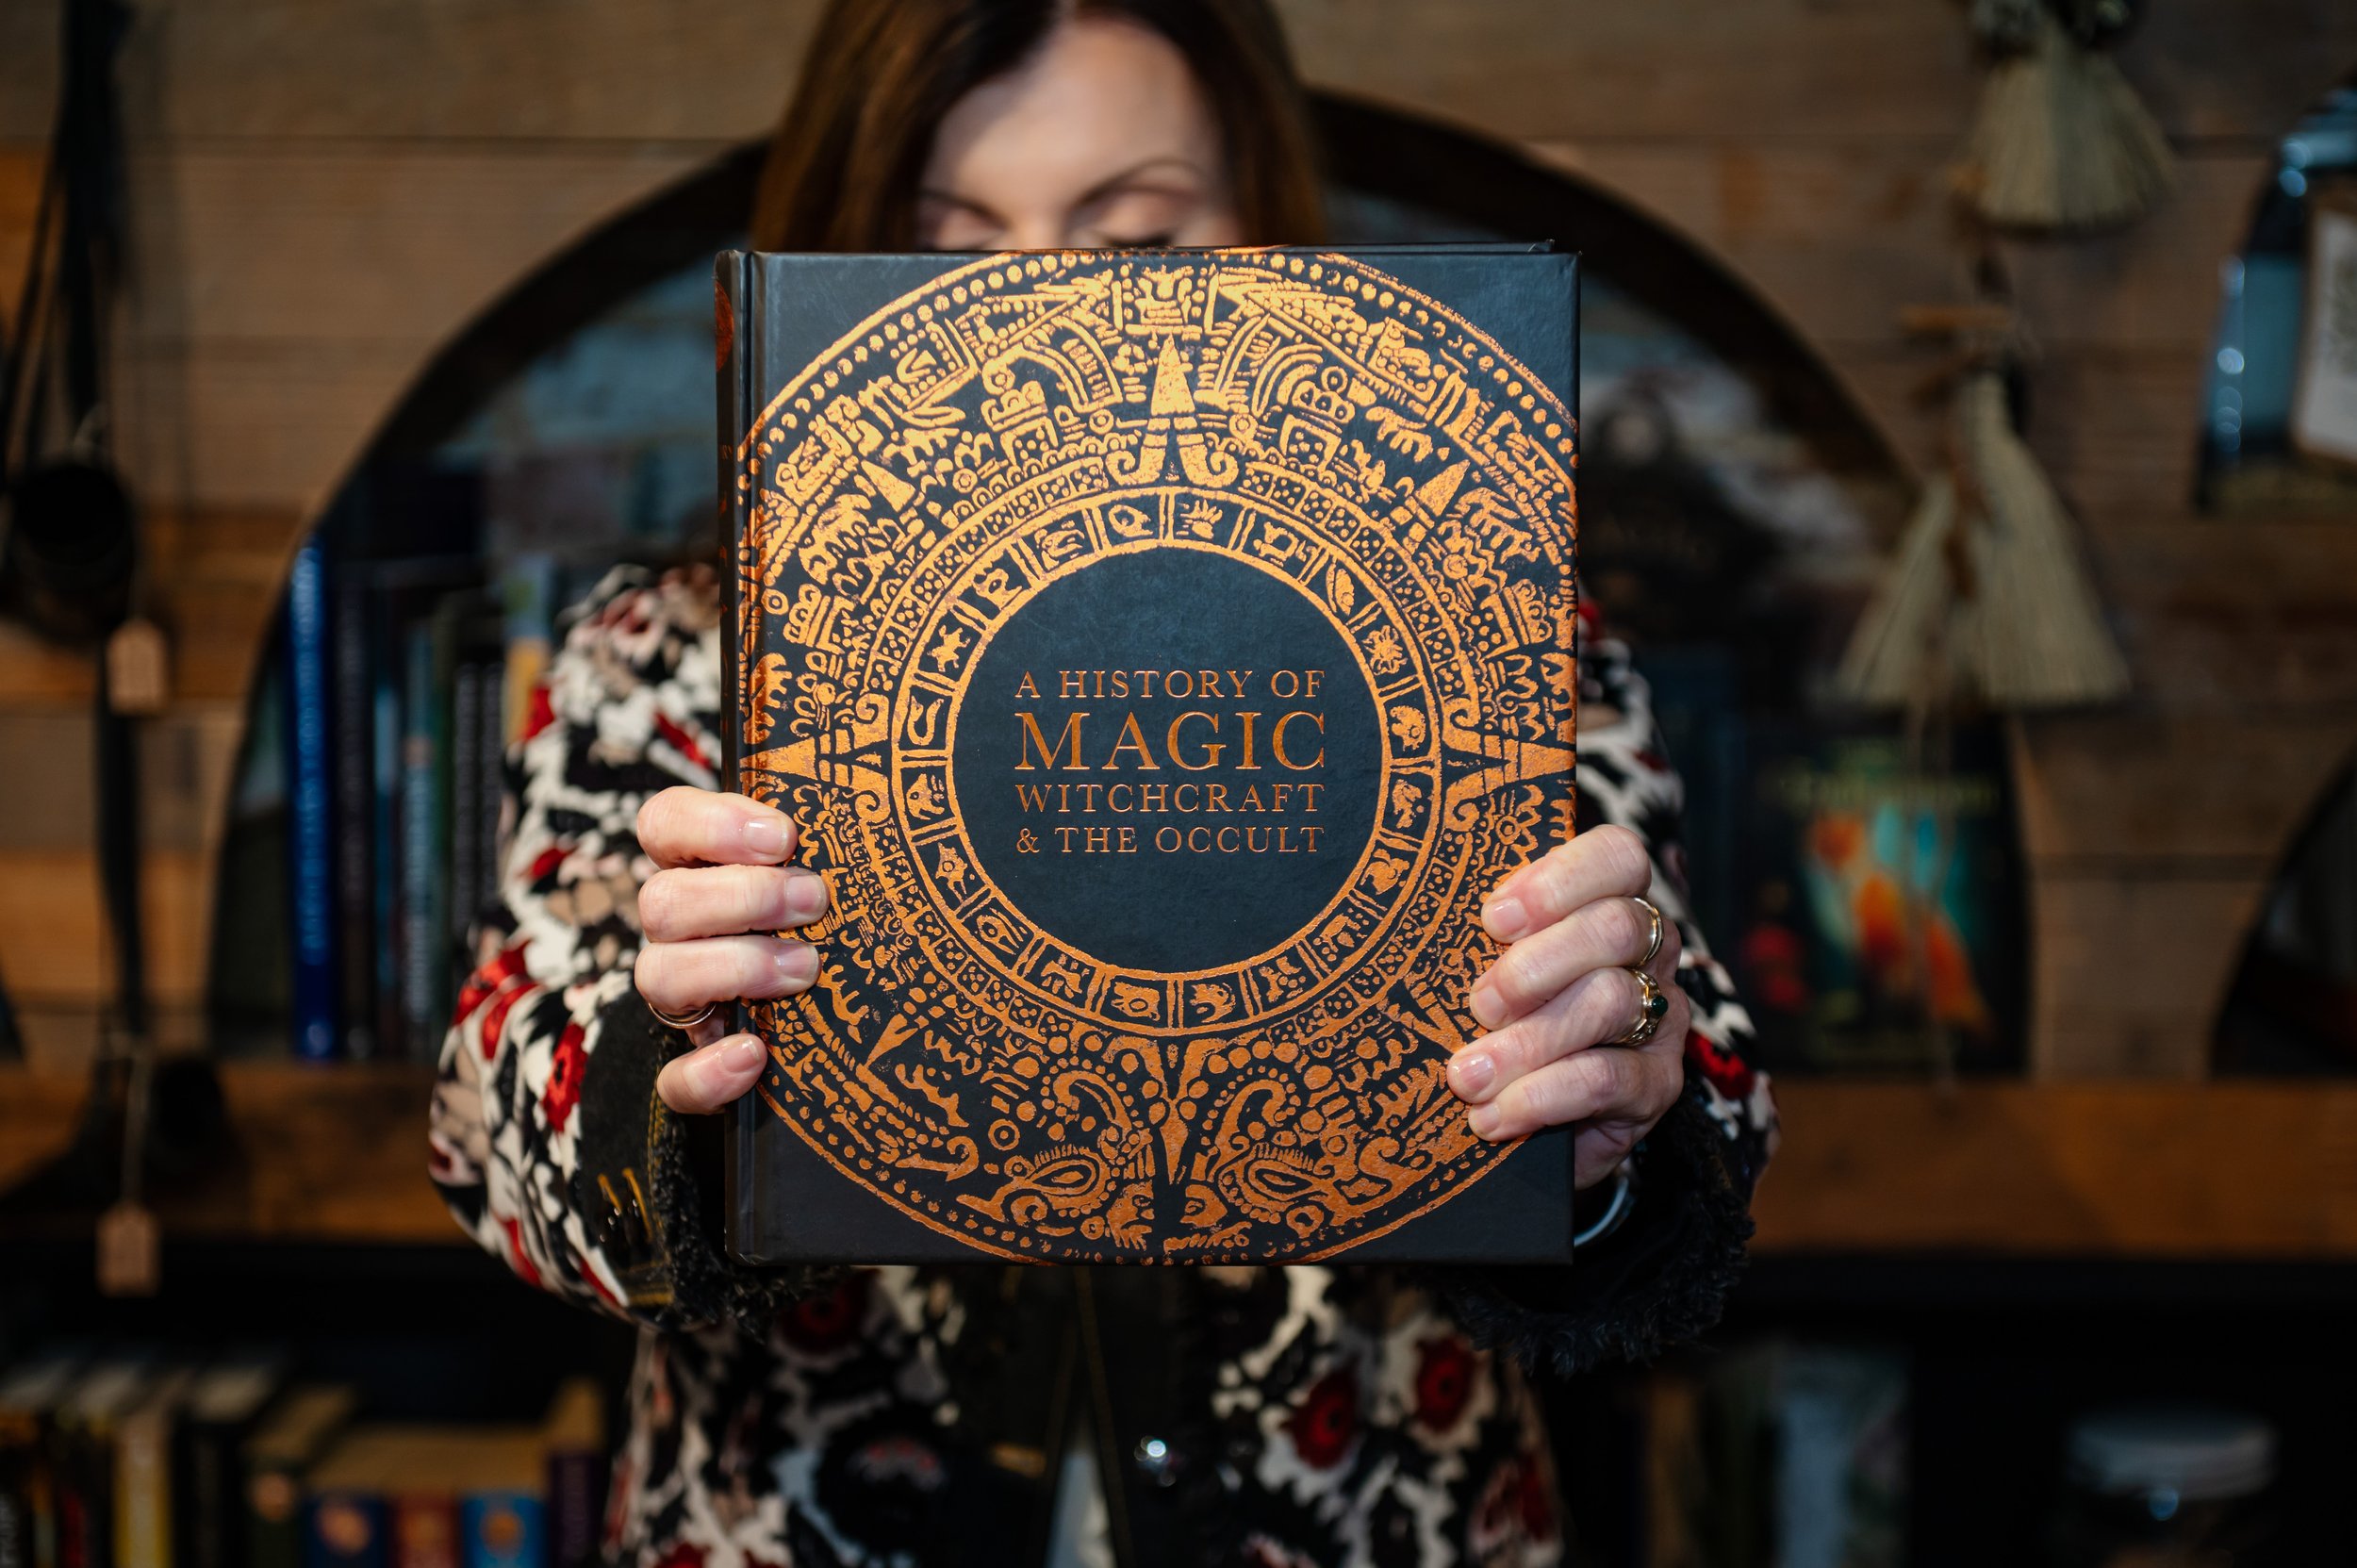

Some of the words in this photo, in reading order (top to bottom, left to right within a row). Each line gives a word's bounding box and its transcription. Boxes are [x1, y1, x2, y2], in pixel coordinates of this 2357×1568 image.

[1014, 670, 1041, 698] A
[1059, 670, 1252, 698] HISTORY
[1271, 670, 1325, 698] OF
[1014, 711, 1325, 770] MAGIC
[1014, 784, 1325, 812] WITCHCRAFT
[1016, 827, 1040, 853] &
[1055, 827, 1137, 852] THE
[1155, 827, 1325, 853] OCCULT
